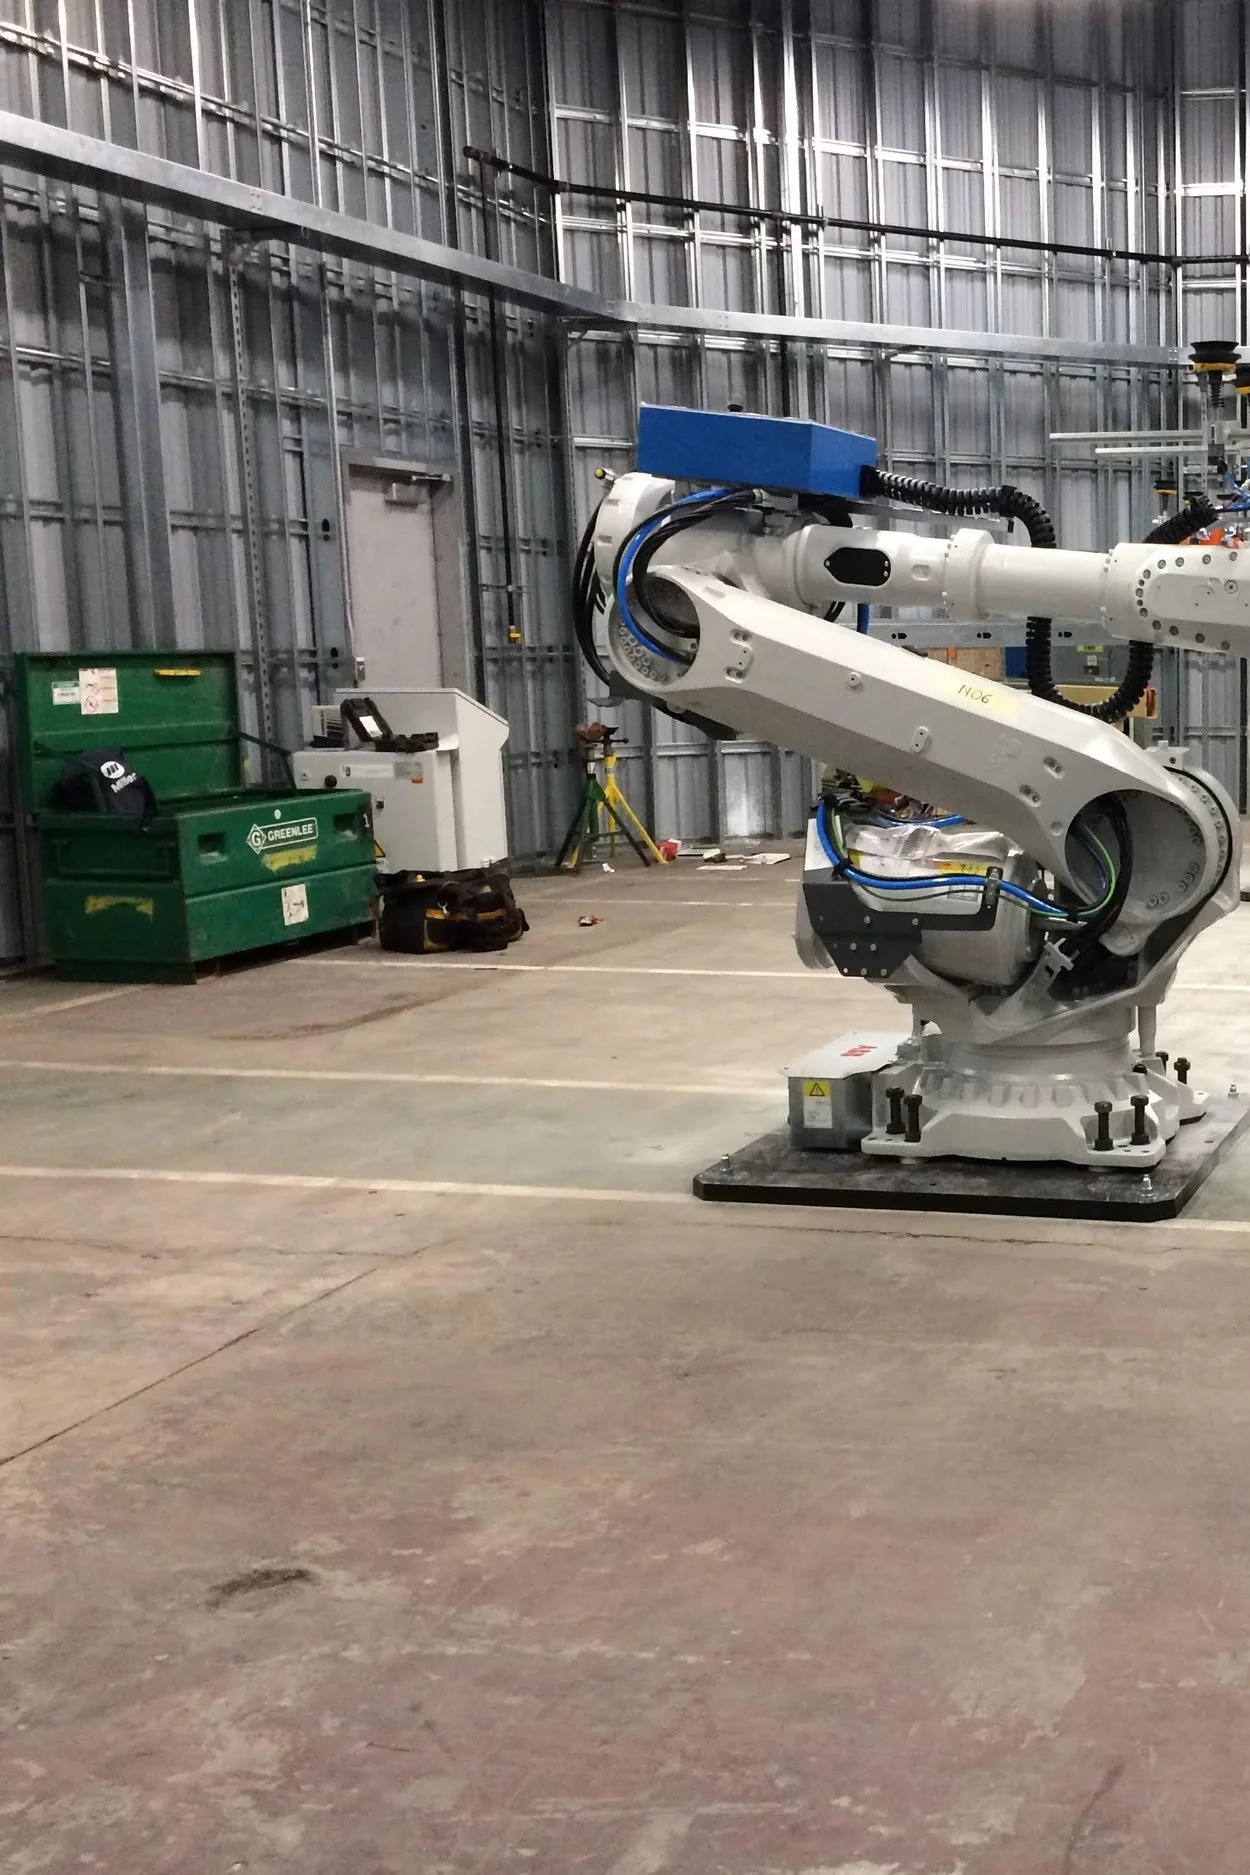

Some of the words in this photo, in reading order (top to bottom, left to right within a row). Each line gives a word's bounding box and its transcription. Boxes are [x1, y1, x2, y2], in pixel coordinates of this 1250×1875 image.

[110, 772, 137, 793] Miller
[251, 831, 261, 847] G
[267, 823, 314, 841] GREENLEE
